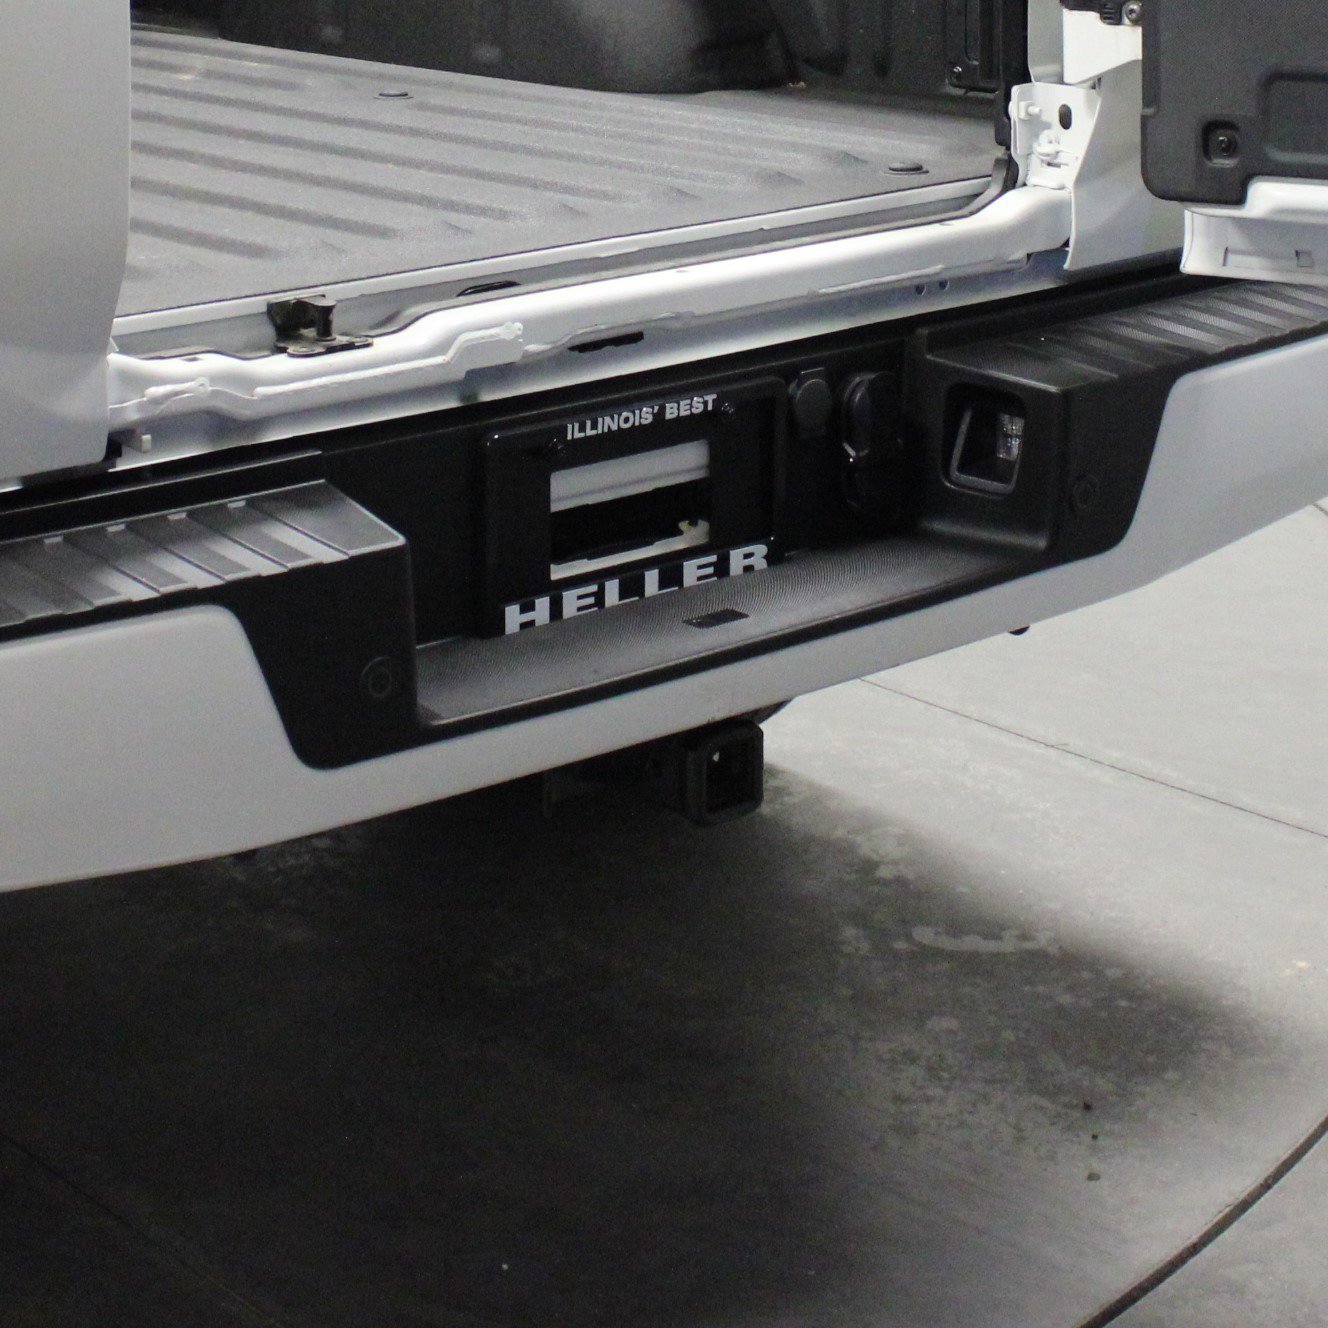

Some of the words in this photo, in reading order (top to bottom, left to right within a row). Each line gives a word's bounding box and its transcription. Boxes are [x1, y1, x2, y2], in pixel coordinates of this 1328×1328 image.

[567, 405, 660, 440] ILLINOIS'
[665, 394, 717, 420] BEST
[504, 544, 769, 635] HELLER
